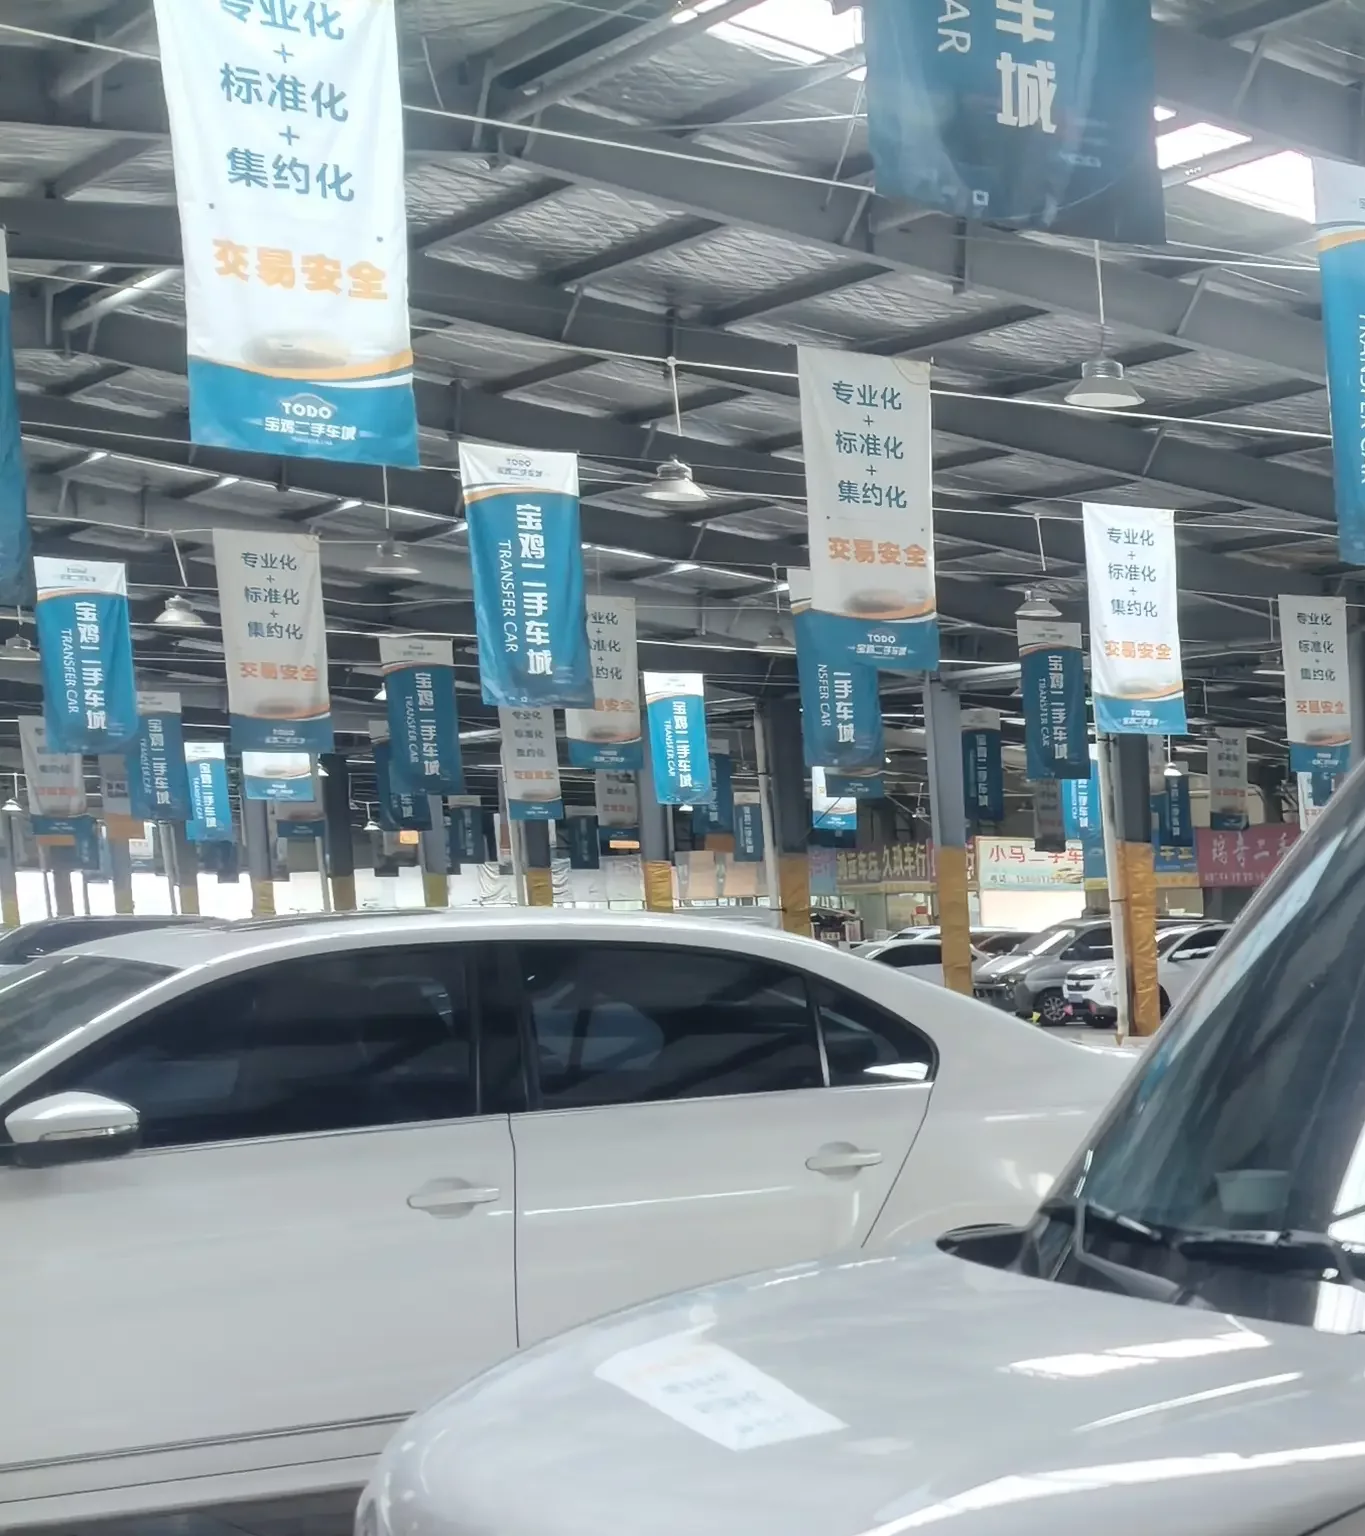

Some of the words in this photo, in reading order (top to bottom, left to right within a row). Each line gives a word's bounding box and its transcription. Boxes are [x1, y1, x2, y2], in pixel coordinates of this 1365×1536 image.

[219, 61, 349, 122] 标准化
[226, 147, 356, 202] 集约化
[211, 237, 388, 300] 交易安全
[831, 381, 902, 410] 专业化
[282, 402, 332, 420] TODO
[264, 416, 357, 441] 宝鸡二手车城
[835, 431, 904, 460] 标准化
[837, 480, 907, 509] 集约化
[1105, 527, 1155, 548] 专业化
[241, 552, 298, 571] 专业化
[828, 537, 926, 568] 交易安全
[498, 539, 516, 616] TRANSFER
[1107, 561, 1157, 583] 标准化
[244, 586, 301, 605] 标准化
[516, 504, 554, 675] 宝鸡二手车城
[585, 611, 620, 626] 业化
[1110, 597, 1159, 618] 集约化
[247, 621, 304, 640] 集约化
[503, 621, 519, 653] CAR
[60, 628, 76, 688] TRANSFER
[590, 639, 622, 654] 准化
[1104, 639, 1173, 662] 交易安全
[75, 601, 107, 730] 宝鸡二手车城
[239, 661, 319, 682] 交易安全
[591, 667, 623, 681] 约化
[66, 690, 80, 714] CAR
[819, 703, 832, 727] CAR
